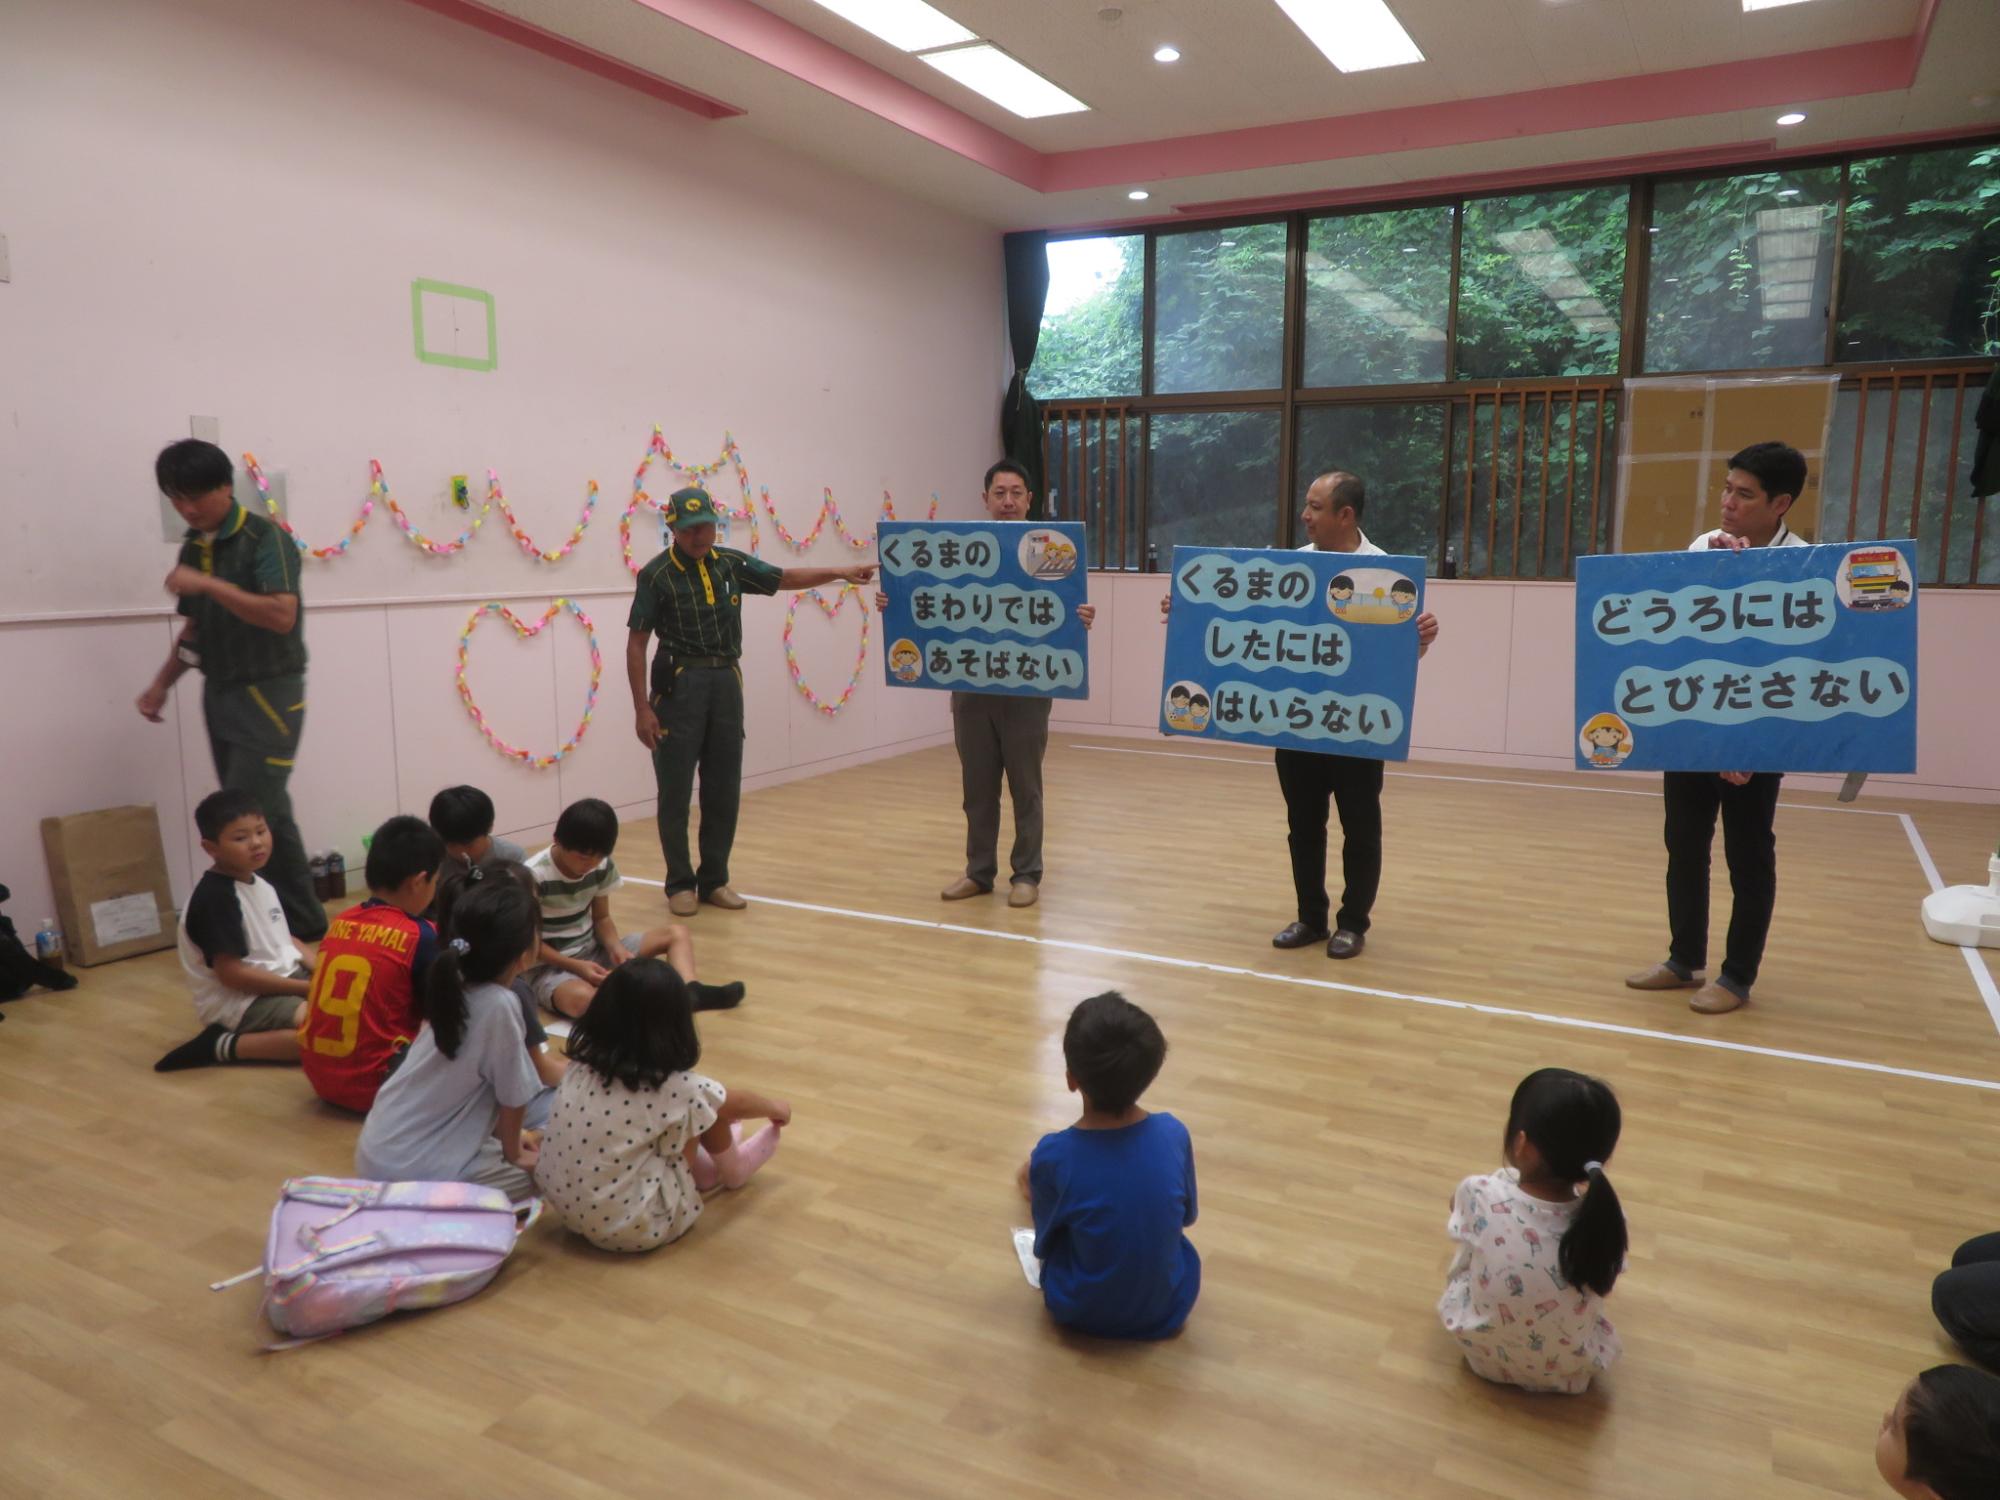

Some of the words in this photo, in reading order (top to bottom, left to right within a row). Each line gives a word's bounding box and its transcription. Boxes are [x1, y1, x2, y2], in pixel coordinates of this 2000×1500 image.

[883, 538, 991, 569] くるまの
[1181, 564, 1310, 602] くるまの
[914, 591, 1056, 626] まわりでは
[1597, 590, 1826, 636] どうろには
[929, 647, 1073, 682] あそばない
[1212, 625, 1344, 667] したには
[1621, 669, 1905, 715] とびださない
[1215, 690, 1392, 735] はいらない
[357, 923, 409, 953] YAMAL
[298, 951, 372, 1057] 19
